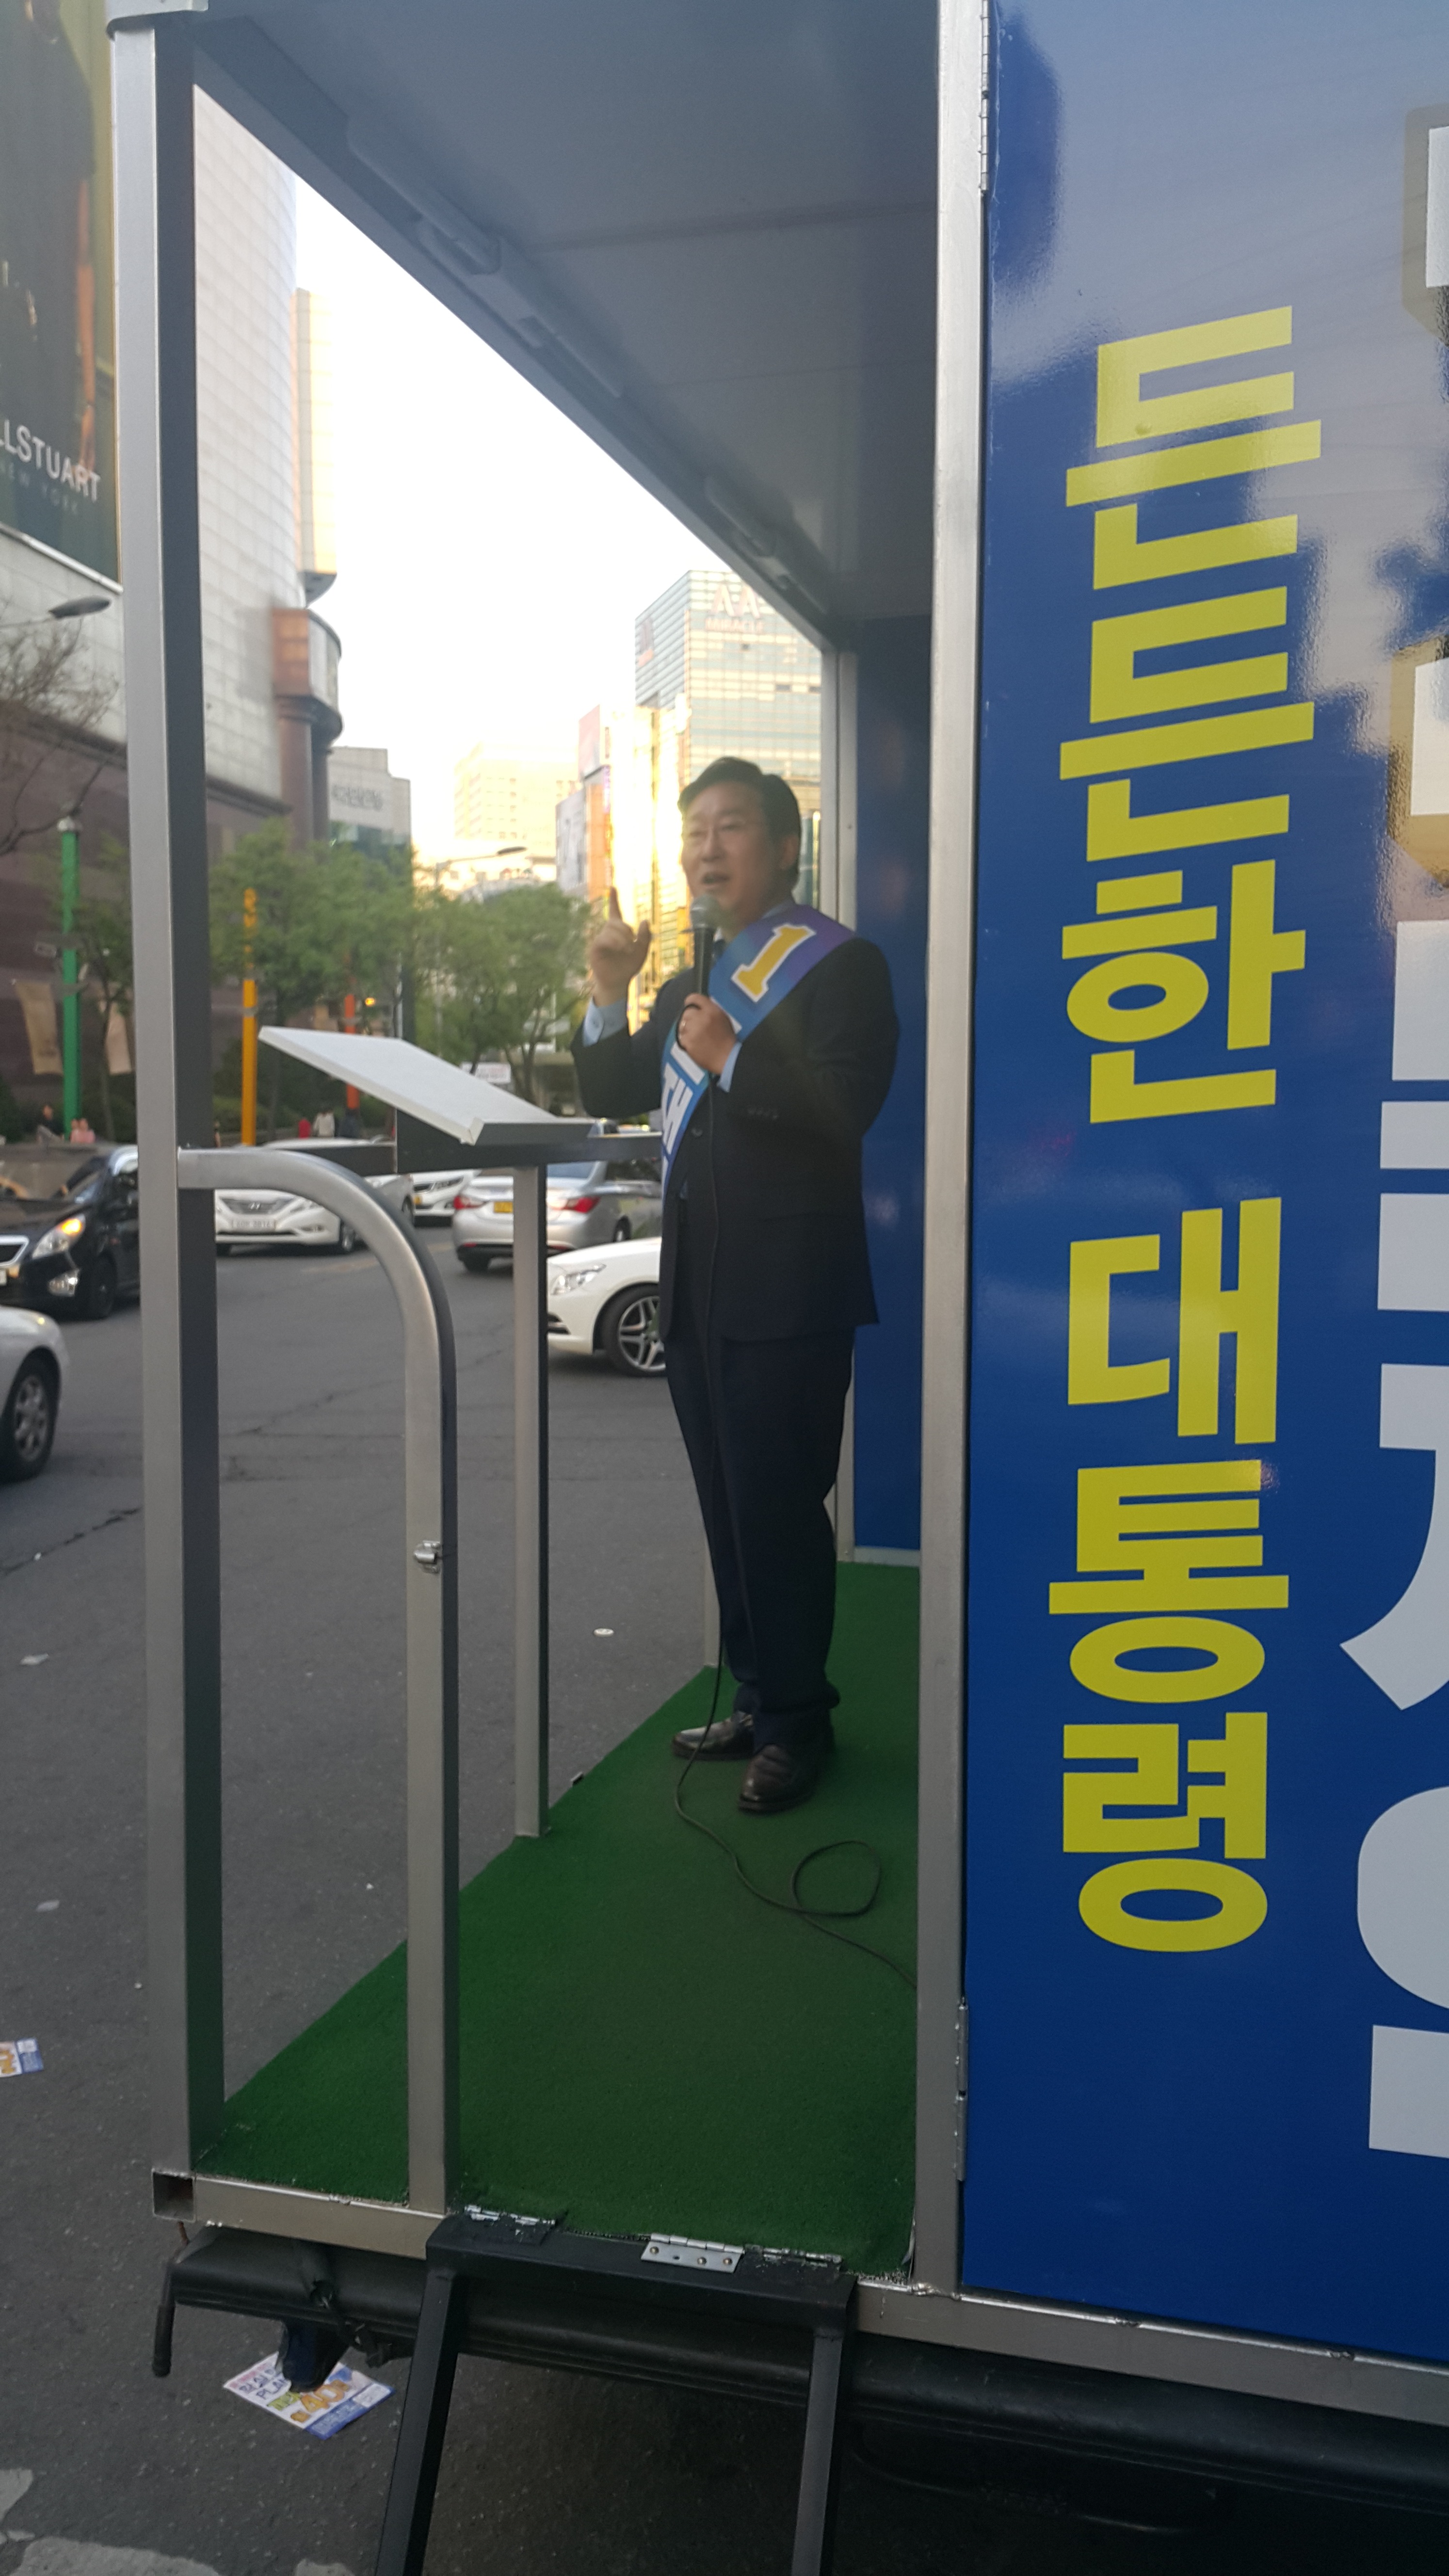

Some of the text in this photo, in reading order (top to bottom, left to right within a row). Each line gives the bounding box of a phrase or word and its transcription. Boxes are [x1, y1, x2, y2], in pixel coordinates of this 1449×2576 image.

[731, 923, 817, 1003] 1
[1049, 308, 1319, 1951] 든든한 대통령
